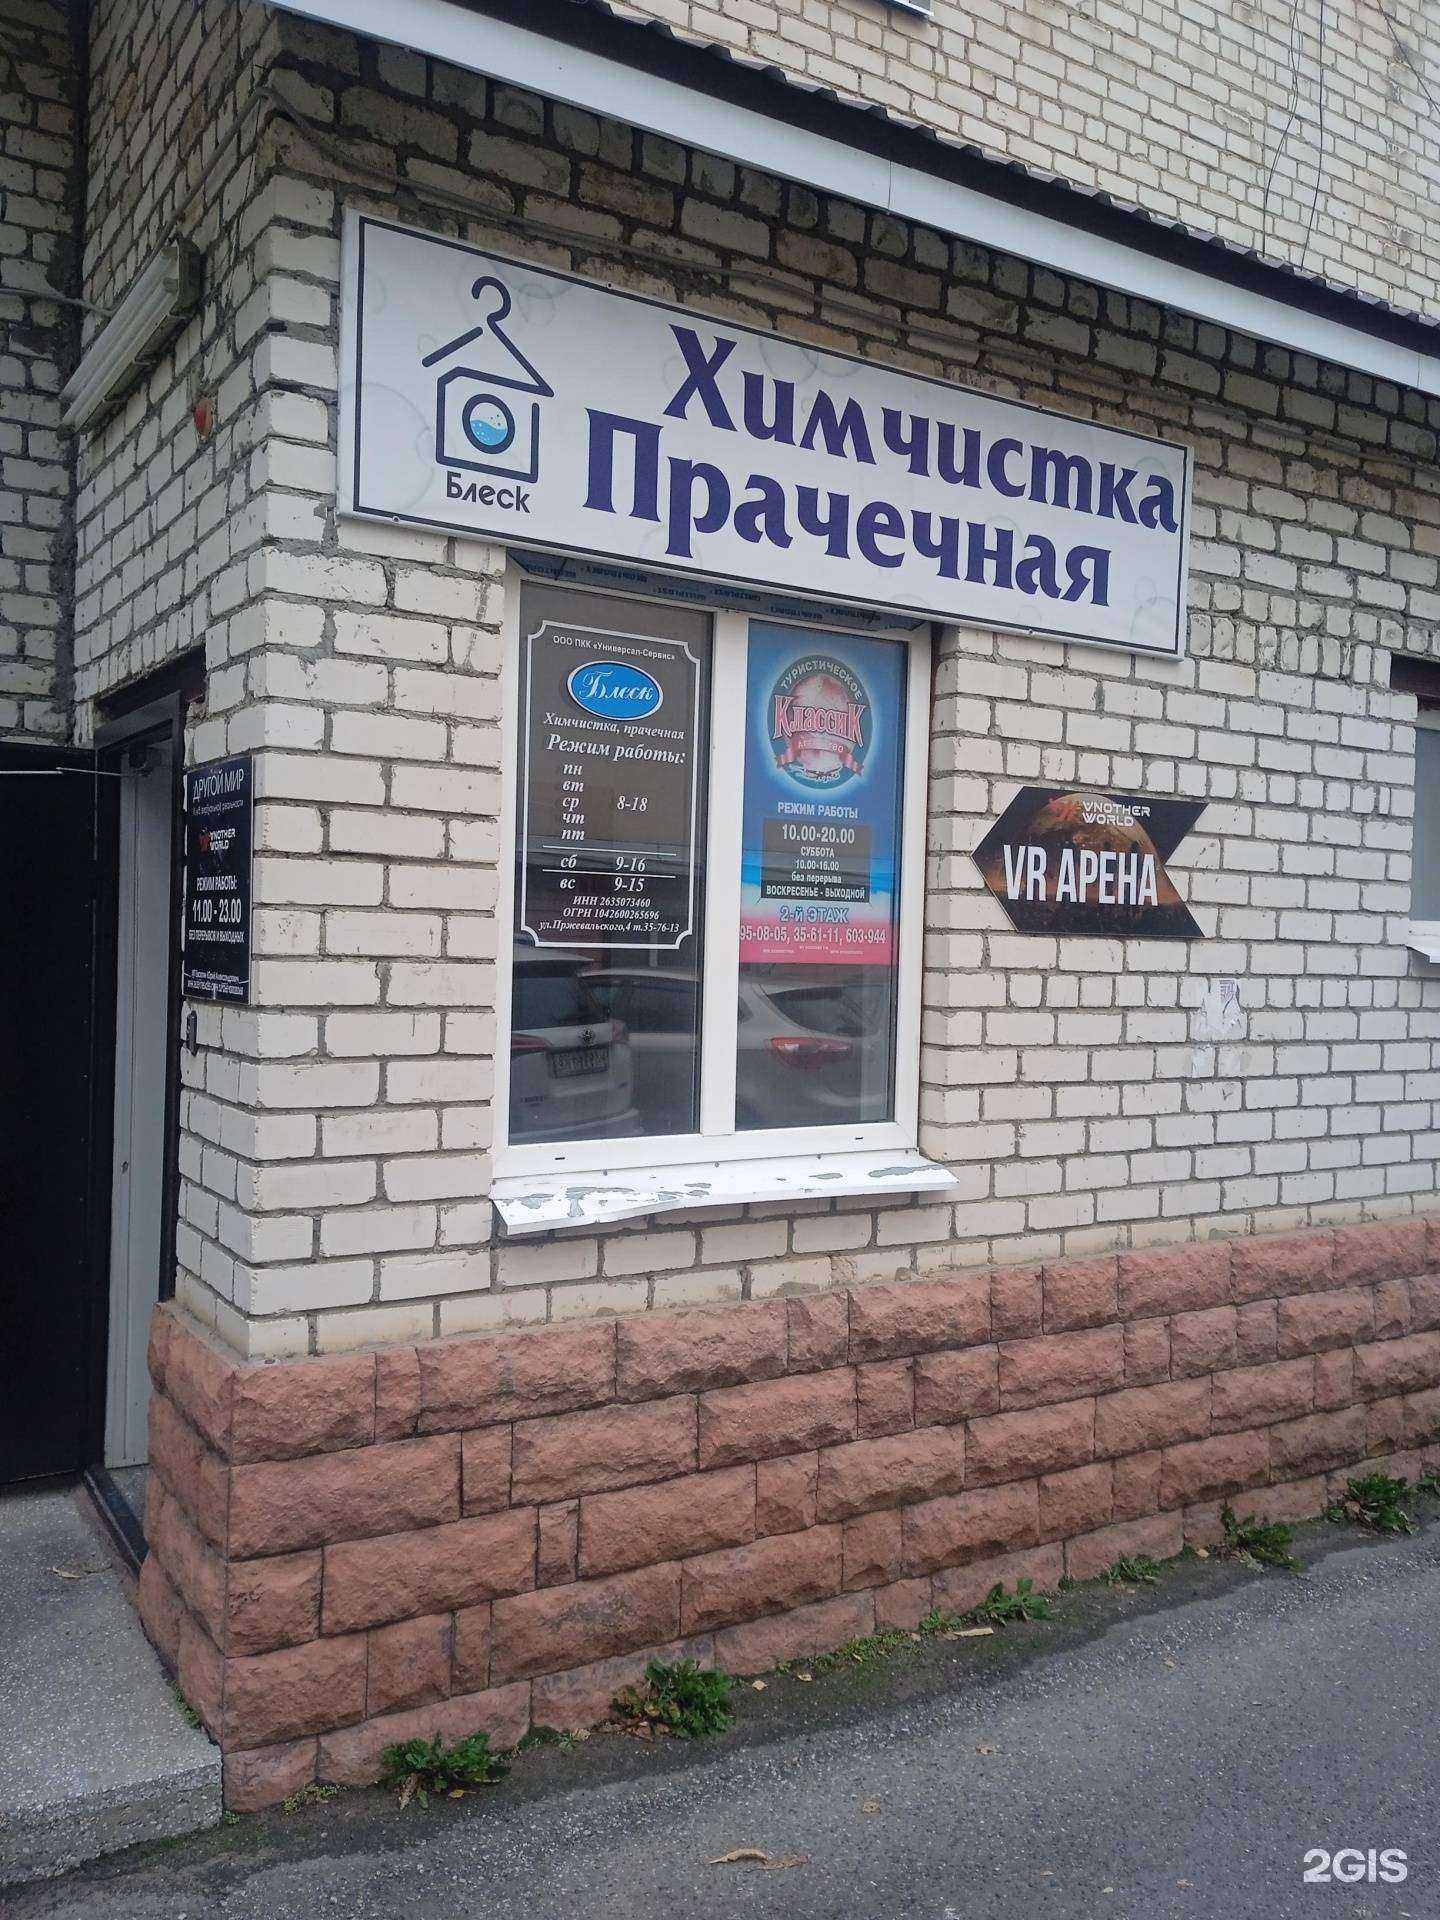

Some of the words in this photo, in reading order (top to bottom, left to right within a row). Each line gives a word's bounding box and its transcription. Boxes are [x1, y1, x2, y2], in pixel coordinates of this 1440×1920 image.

[663, 323, 1179, 533] Химчистка
[446, 470, 531, 514] Блеск
[584, 407, 1112, 607] Прачечная
[552, 635, 574, 646] ООО
[574, 638, 592, 648] ПКК
[578, 670, 655, 701] Блеск
[780, 659, 863, 701] ТУРИСТИЧЕСКОЕ
[543, 711, 620, 734] Химчистка,
[623, 723, 685, 740] прачечная
[546, 733, 611, 757] Режим
[613, 743, 687, 765] работы:
[563, 763, 583, 776] пн
[193, 769, 224, 803] ДРУГОЙ
[225, 768, 244, 793] МИР
[562, 779, 584, 793] вт
[562, 796, 580, 812] ср
[616, 795, 648, 812] 8-18
[778, 802, 816, 816] РЕЖИМ
[818, 805, 858, 819] РАБОТЫ
[562, 812, 585, 825] чт
[1082, 812, 1134, 827] WORLD
[561, 828, 585, 841] пт
[782, 823, 855, 844] 10.00-20.00
[800, 846, 835, 858] СУББОТА
[560, 854, 578, 869] сб
[614, 855, 647, 872] 9-16
[795, 859, 839, 872] 10.00-16.00
[559, 876, 576, 890] вс
[613, 876, 645, 892] 9-15
[791, 871, 804, 882] без
[806, 873, 842, 885] перерыва
[1003, 844, 1047, 901] VR
[1056, 848, 1159, 907] АРЕНА
[573, 895, 598, 906] ИНН
[766, 884, 818, 897] ВОСКРЕСЕНЬЕ
[825, 886, 865, 900] ВЫХОДНОЙ
[193, 899, 213, 923] 11.00
[219, 898, 242, 923] 23.00
[563, 907, 592, 918] ОГРН
[807, 906, 849, 923] ЭТАЖ
